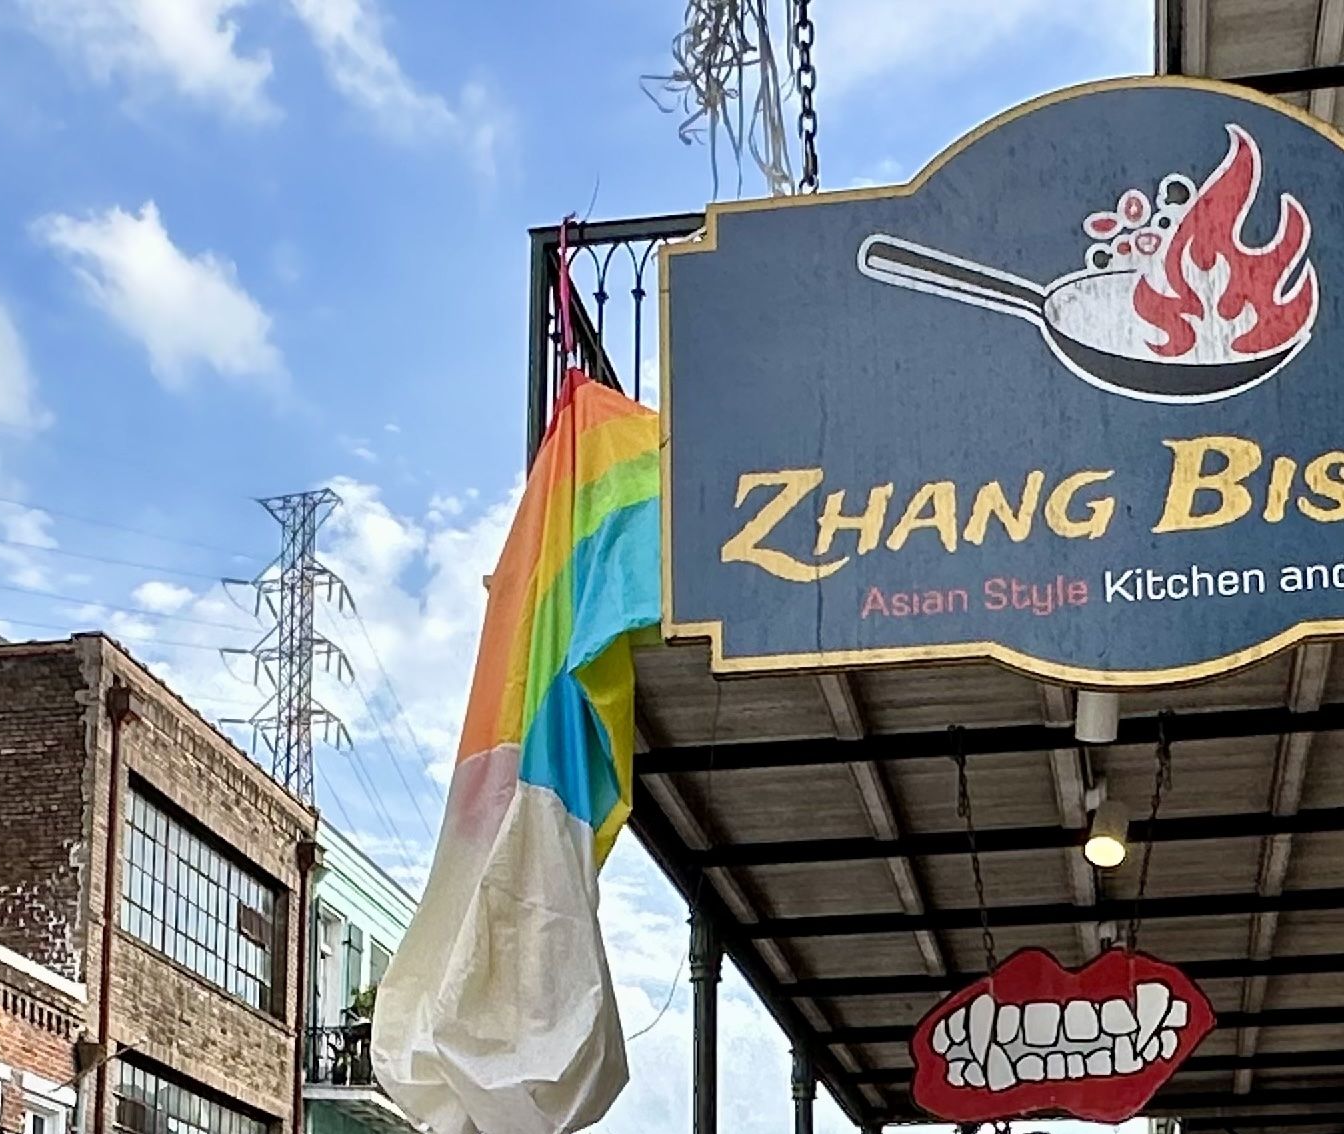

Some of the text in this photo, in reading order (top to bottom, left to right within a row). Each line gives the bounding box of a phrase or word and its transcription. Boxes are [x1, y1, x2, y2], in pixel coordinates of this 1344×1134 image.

[720, 466, 1116, 583] ZHANG
[861, 585, 968, 619] Asian
[984, 573, 1089, 616] Style
[1104, 562, 1265, 604] Kitchen
